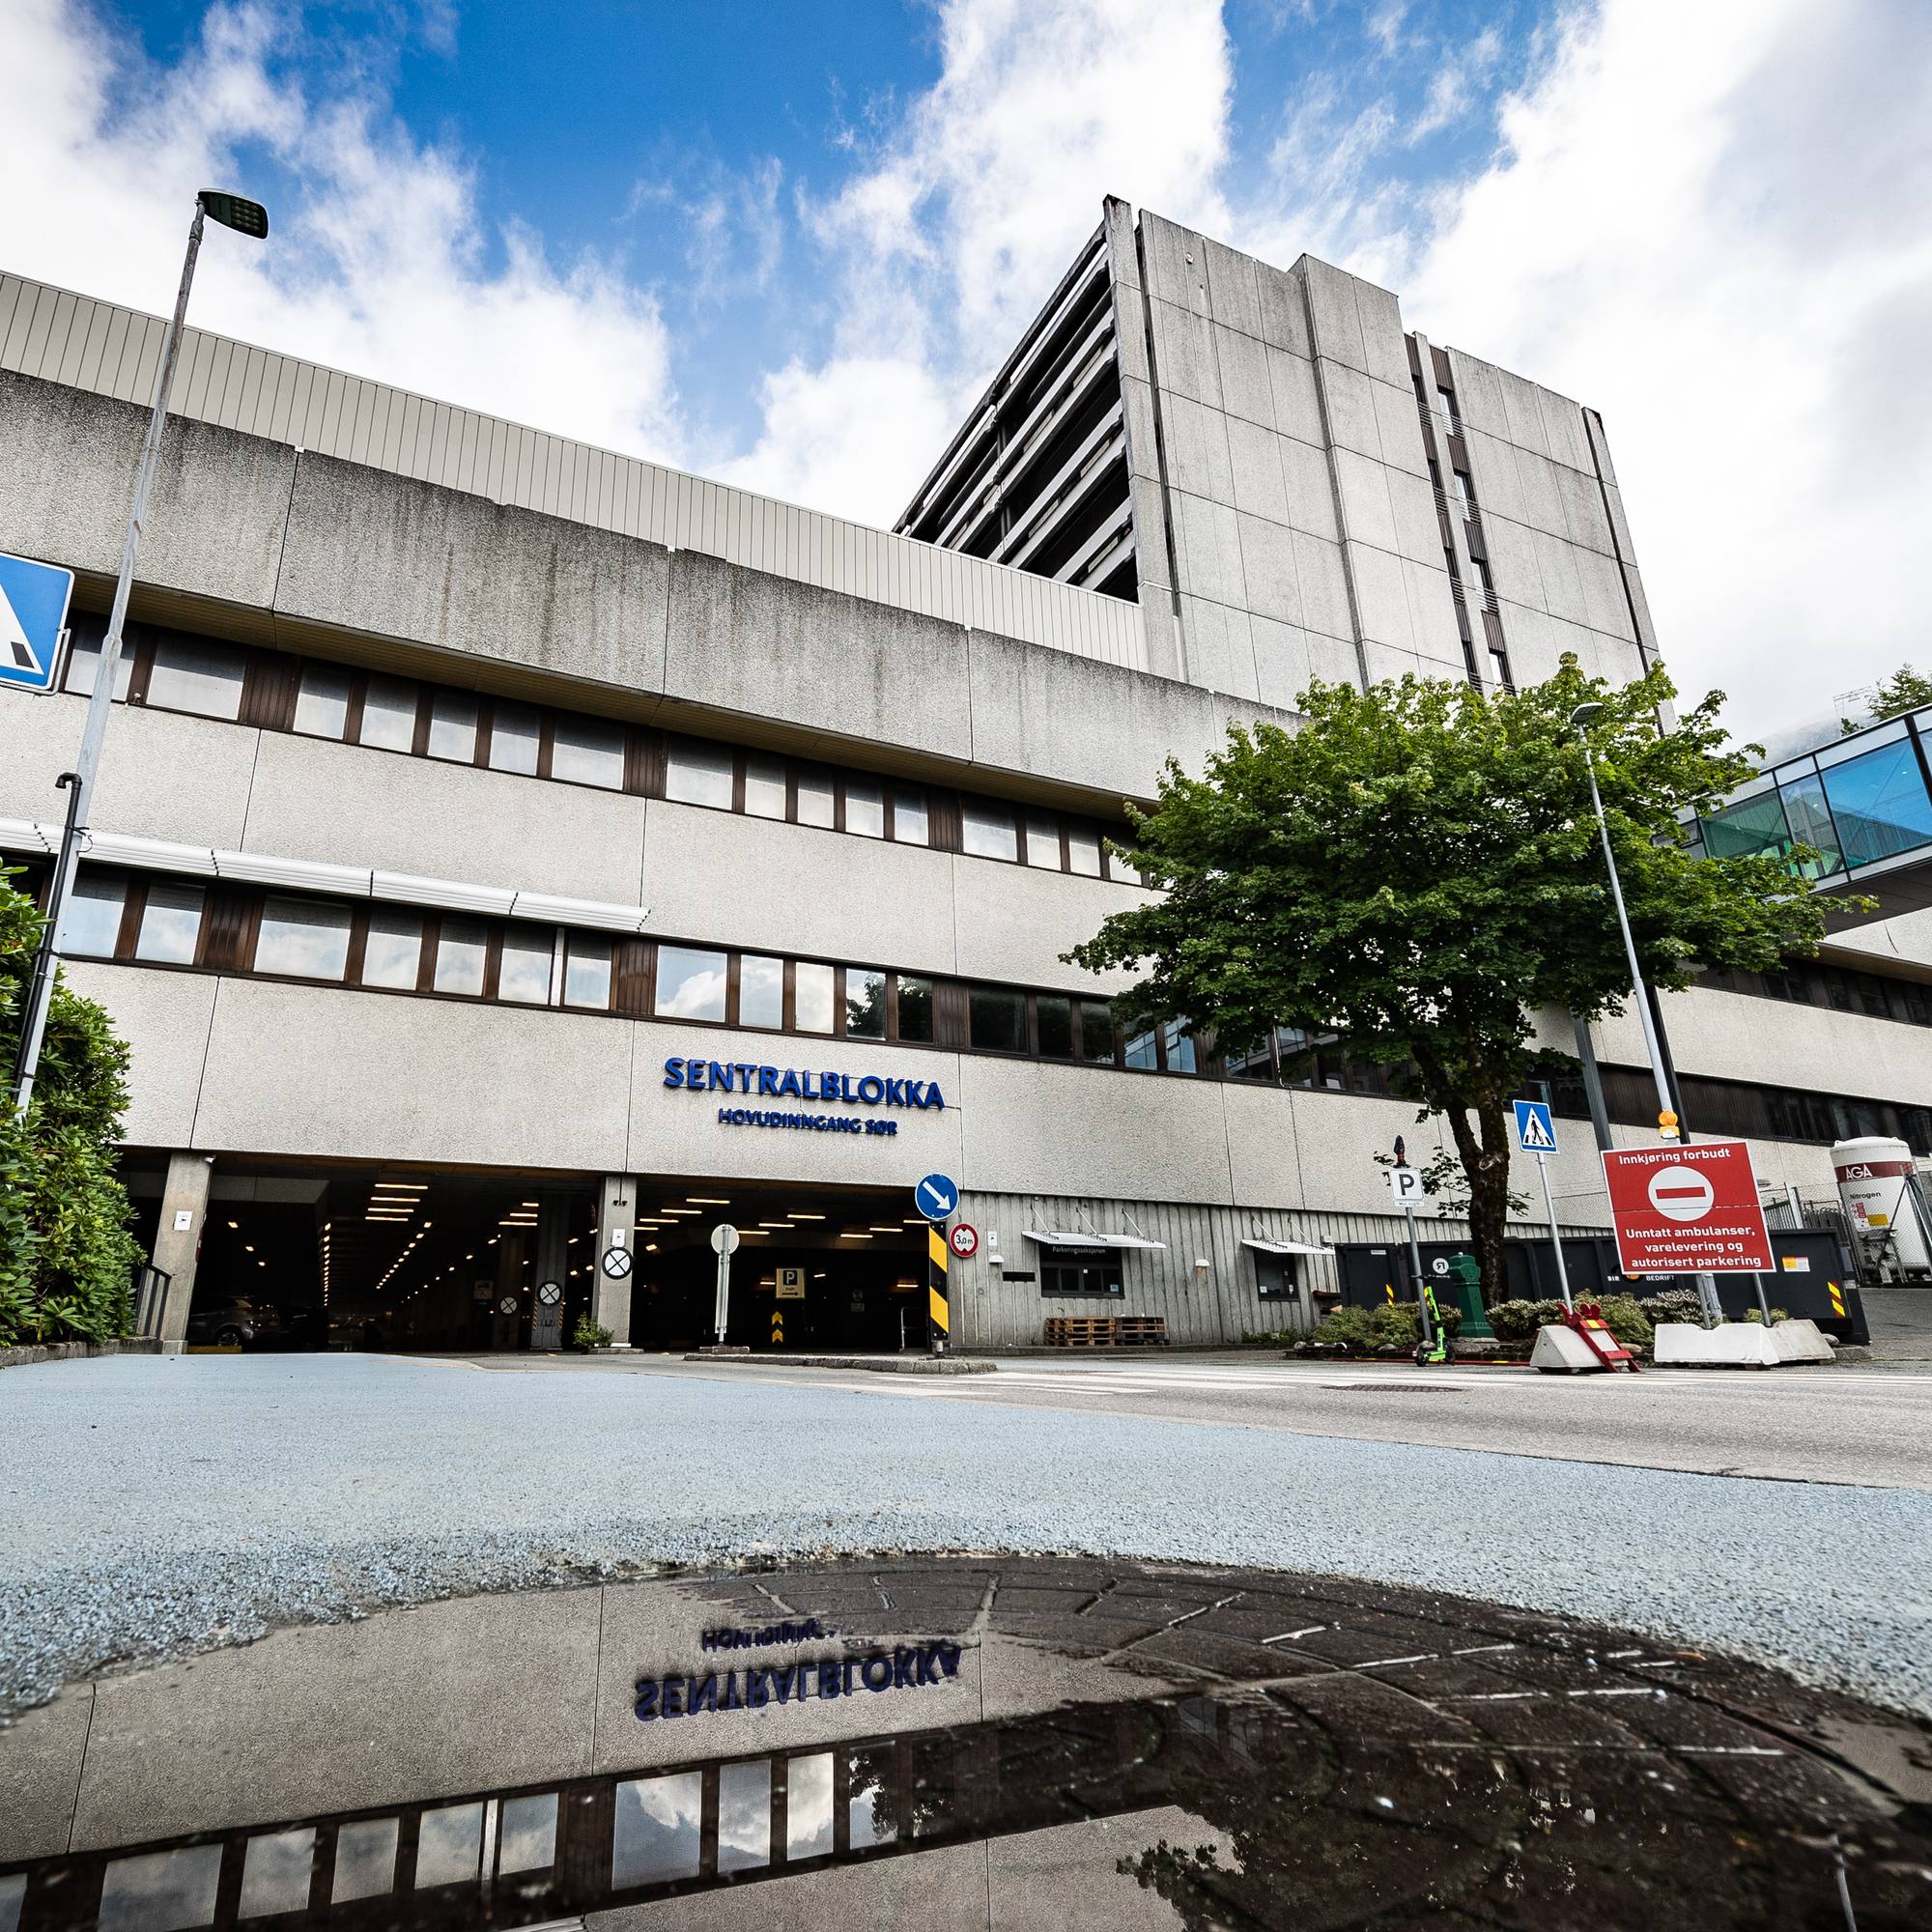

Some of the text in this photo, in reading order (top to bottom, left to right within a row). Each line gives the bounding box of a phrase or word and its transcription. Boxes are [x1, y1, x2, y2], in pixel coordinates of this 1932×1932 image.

[664, 1057, 945, 1110] SENTRALBLOKKA
[718, 1107, 897, 1135] HOVUDINNGANG SØR
[1619, 1148, 1731, 1165] Innkjøring forbudt
[1845, 1164, 1873, 1180] AGA
[1399, 1174, 1415, 1196] P
[1850, 1191, 1882, 1200] Nitrogen
[1626, 1225, 1755, 1238] Unntatt ambulanser,
[1645, 1241, 1744, 1254] varelevering og
[1632, 1256, 1762, 1268] autorisert parkering
[785, 1271, 795, 1285] P
